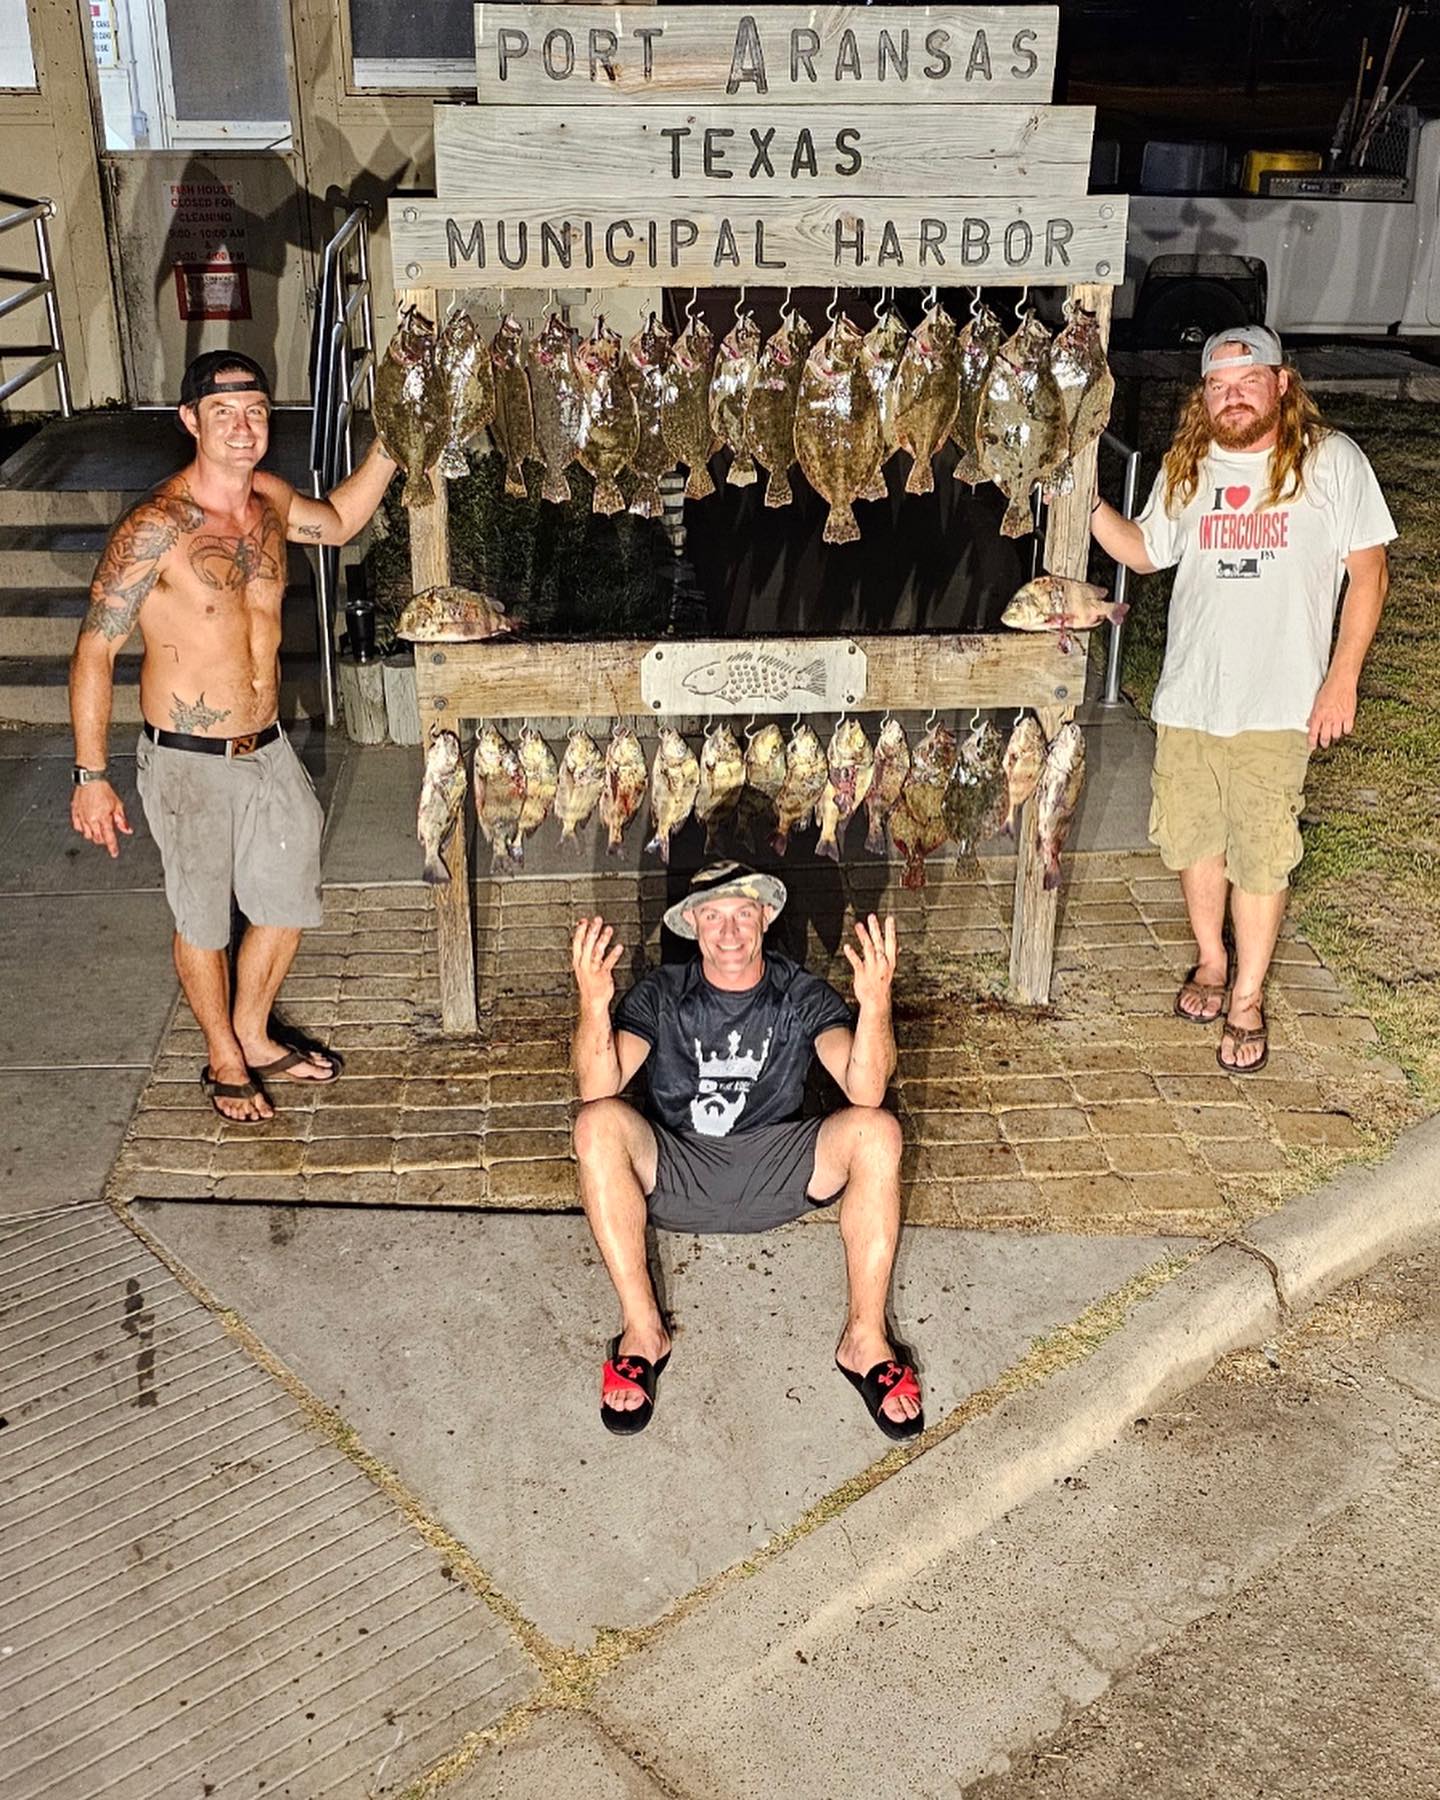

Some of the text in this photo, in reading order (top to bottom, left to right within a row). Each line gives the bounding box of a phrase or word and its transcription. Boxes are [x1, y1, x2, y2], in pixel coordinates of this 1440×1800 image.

[499, 15, 1040, 95] PORT ARANSAS
[660, 126, 863, 179] TEXAS
[170, 185, 234, 195] FISH HOUSE
[171, 198, 236, 208] CLOSED FOR
[179, 212, 232, 223] CLEANING
[229, 228, 245, 238] AM
[444, 217, 1075, 270] MUNICIPAL HARBOR
[229, 251, 245, 261] PM
[1212, 487, 1225, 511] I
[1199, 511, 1290, 551] INTERCOURSE
